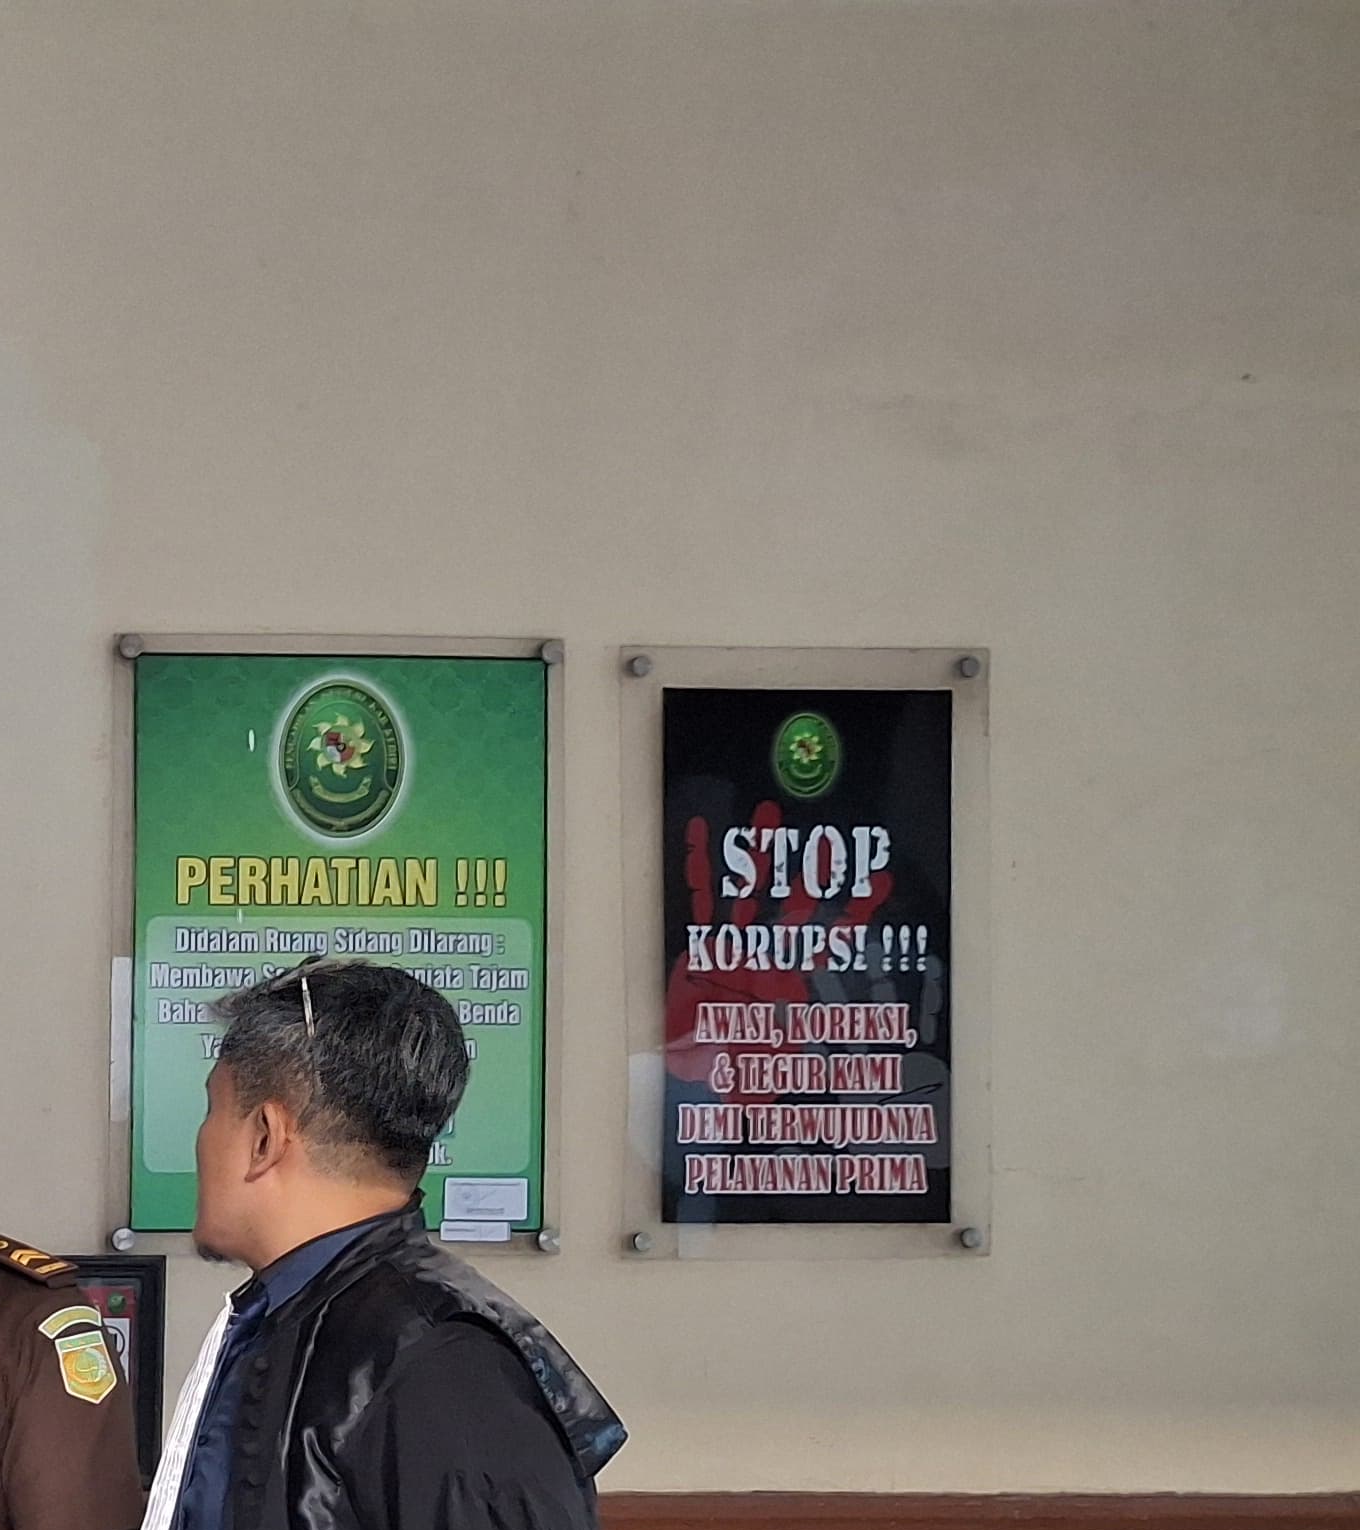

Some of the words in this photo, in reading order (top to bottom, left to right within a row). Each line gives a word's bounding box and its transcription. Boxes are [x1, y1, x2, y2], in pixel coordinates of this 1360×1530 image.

[176, 855, 438, 907] PERHATIAN
[454, 856, 508, 907] !!!
[720, 825, 891, 899] STOP
[176, 928, 258, 953] Didalam
[264, 928, 329, 957] Ruang
[334, 929, 404, 957] Sidang
[686, 923, 869, 972] KORUPSI
[881, 923, 928, 972] !!!
[150, 962, 256, 989] Membawa
[469, 963, 529, 992] Tajam
[158, 998, 213, 1024] Baha
[458, 999, 521, 1025] Benda
[694, 1002, 784, 1048] AWASI,
[787, 1002, 918, 1048] KOREKSI,
[711, 1052, 735, 1094] &
[737, 1054, 826, 1094] TEGUR
[829, 1054, 903, 1094] KAMI
[677, 1103, 743, 1144] DEMI
[746, 1103, 937, 1149] TERWUJUDNYA
[684, 1154, 832, 1194] PELAYANAN
[835, 1154, 928, 1194] PRIMA
